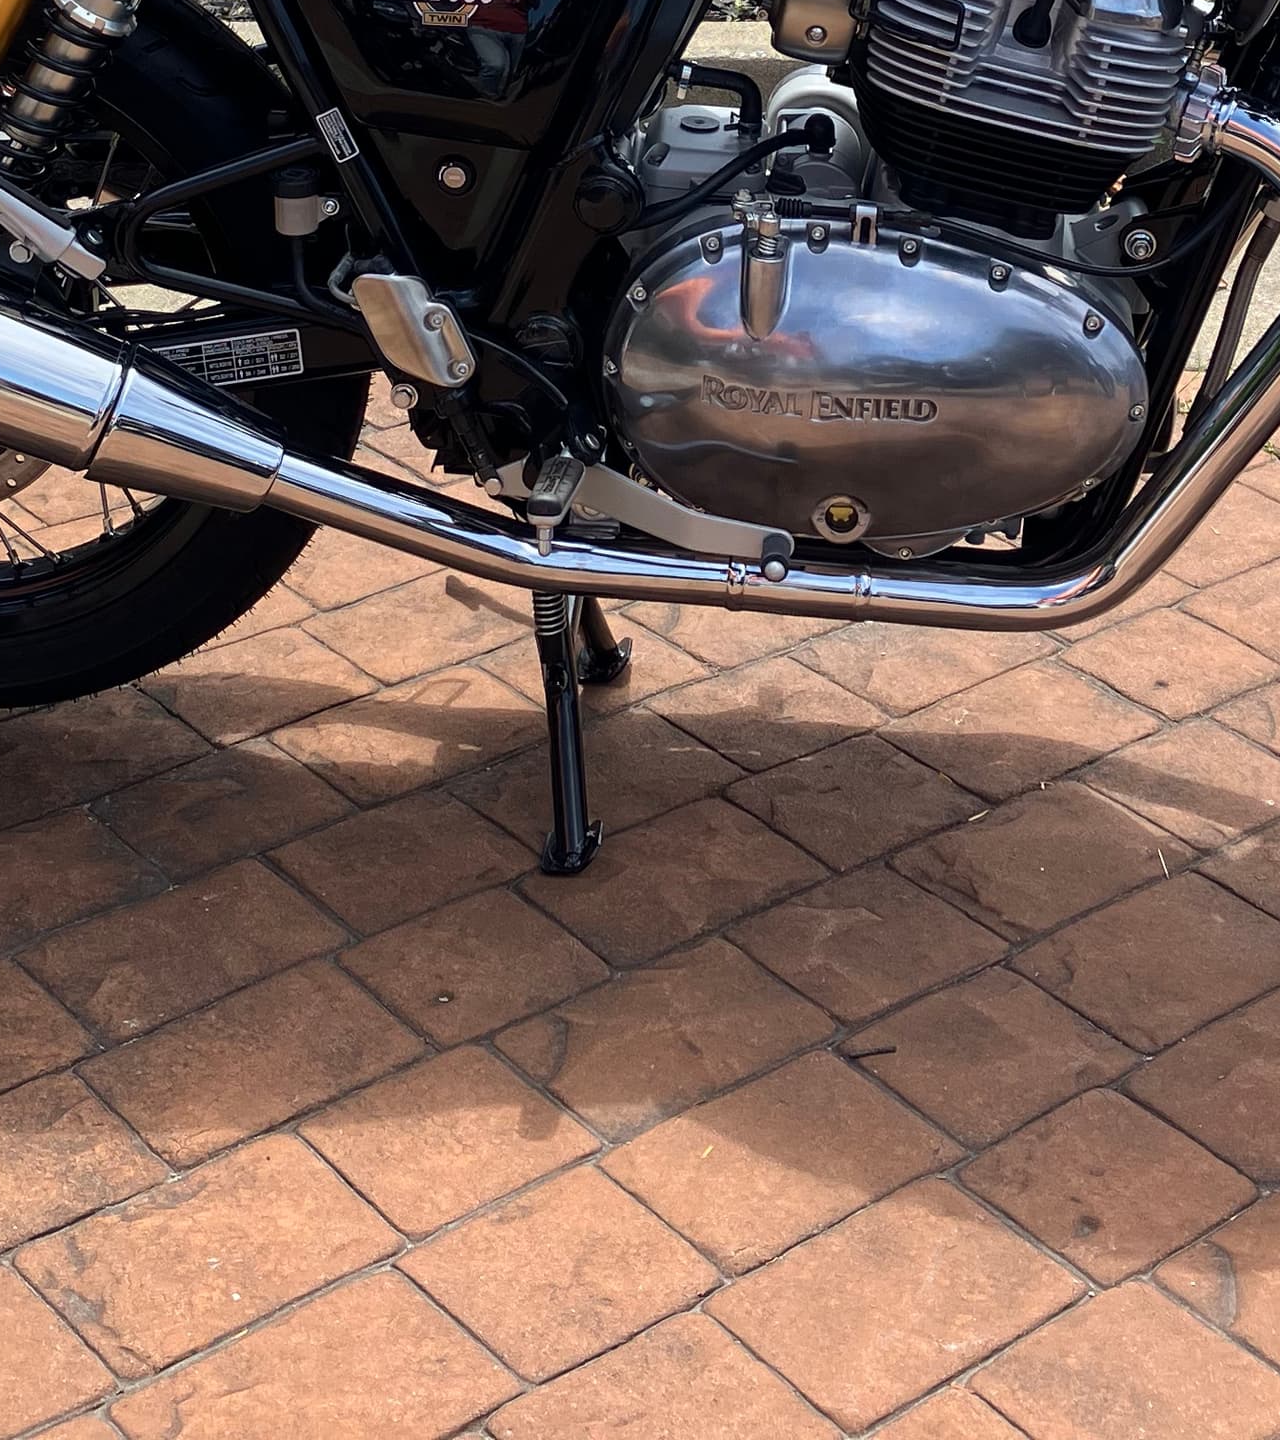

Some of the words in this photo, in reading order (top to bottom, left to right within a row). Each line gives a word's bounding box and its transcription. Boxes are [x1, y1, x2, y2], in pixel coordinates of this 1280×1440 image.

[428, 14, 463, 23] TWIN
[701, 375, 802, 417] ROYAL
[809, 390, 938, 423] ENFIELD
